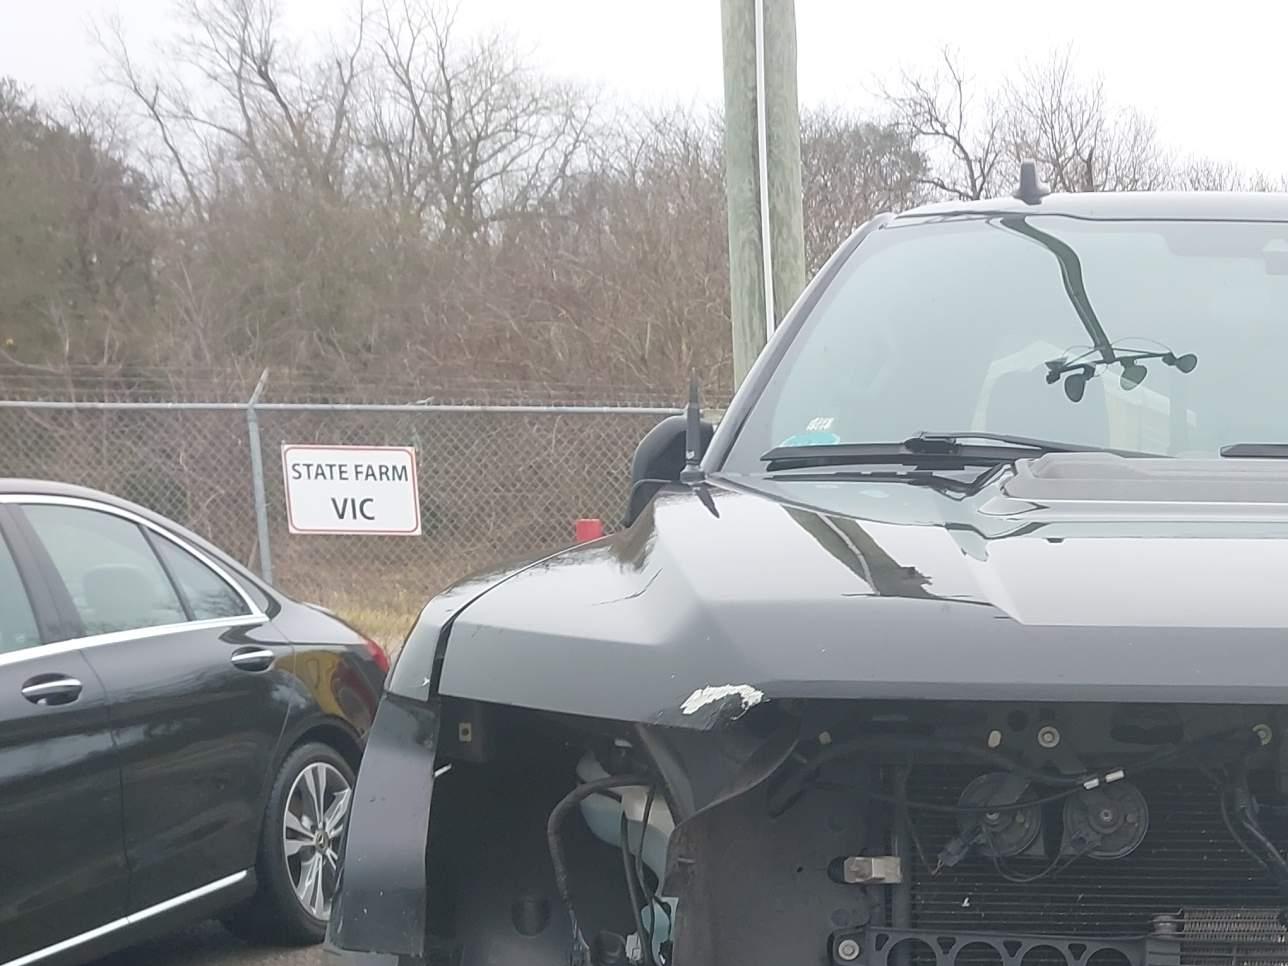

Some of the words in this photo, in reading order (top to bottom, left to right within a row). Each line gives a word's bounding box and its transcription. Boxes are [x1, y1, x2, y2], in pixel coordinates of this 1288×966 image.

[291, 463, 349, 480] STATE
[354, 464, 409, 481] FARM
[331, 497, 375, 520] VIC
